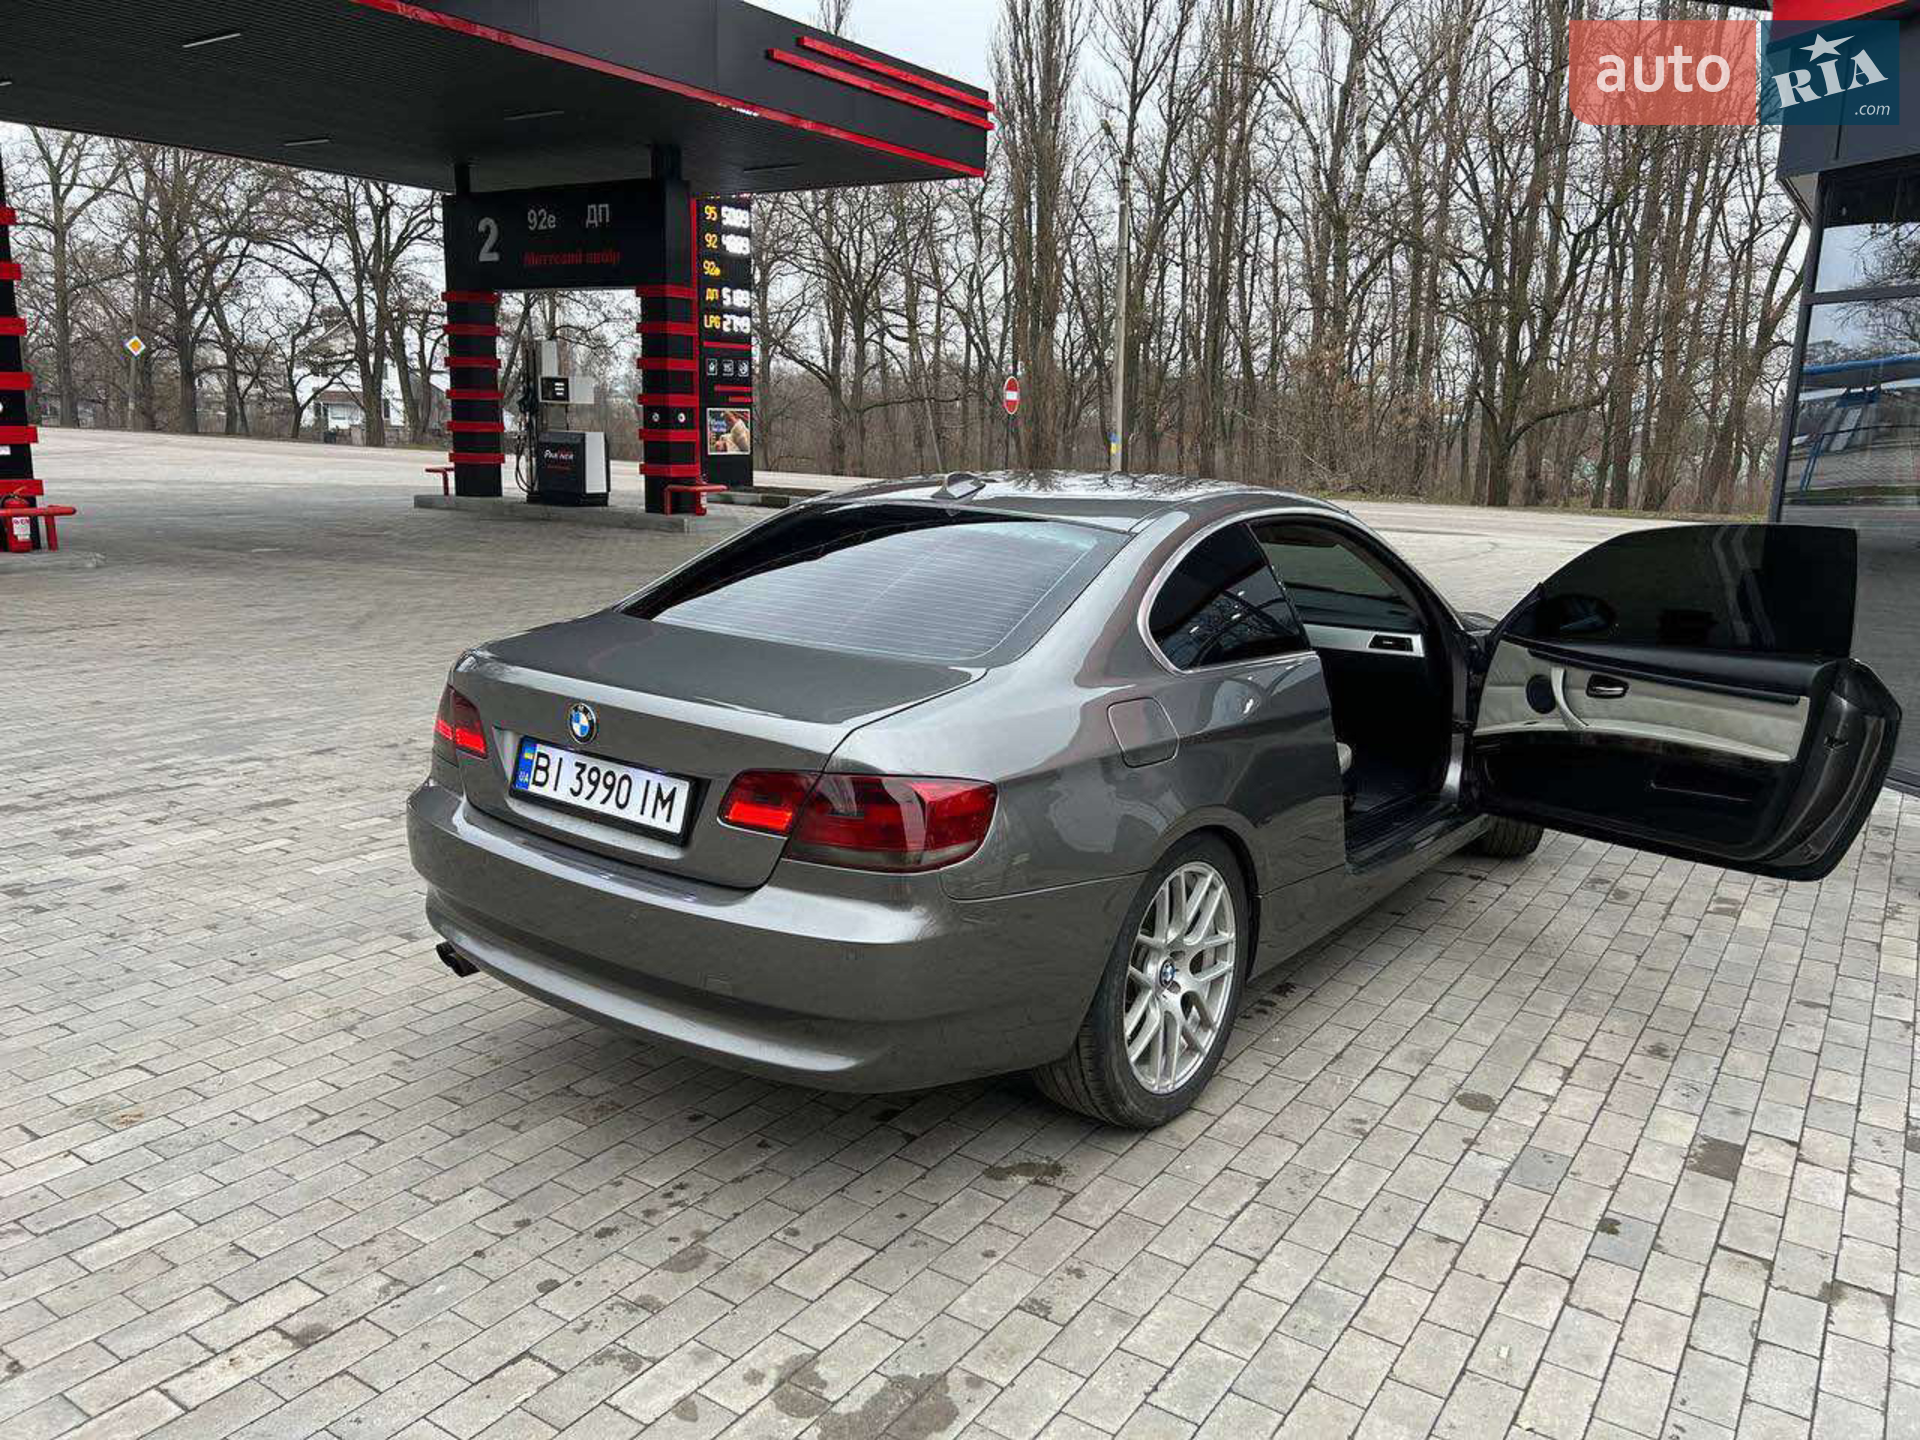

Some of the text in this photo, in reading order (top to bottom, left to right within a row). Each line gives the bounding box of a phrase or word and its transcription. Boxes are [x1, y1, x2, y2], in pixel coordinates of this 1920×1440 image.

[586, 204, 610, 228] ДП
[704, 205, 718, 221] 95
[478, 217, 499, 262] 2
[704, 233, 718, 249] 92
[531, 752, 677, 823] BI 3990 IM
